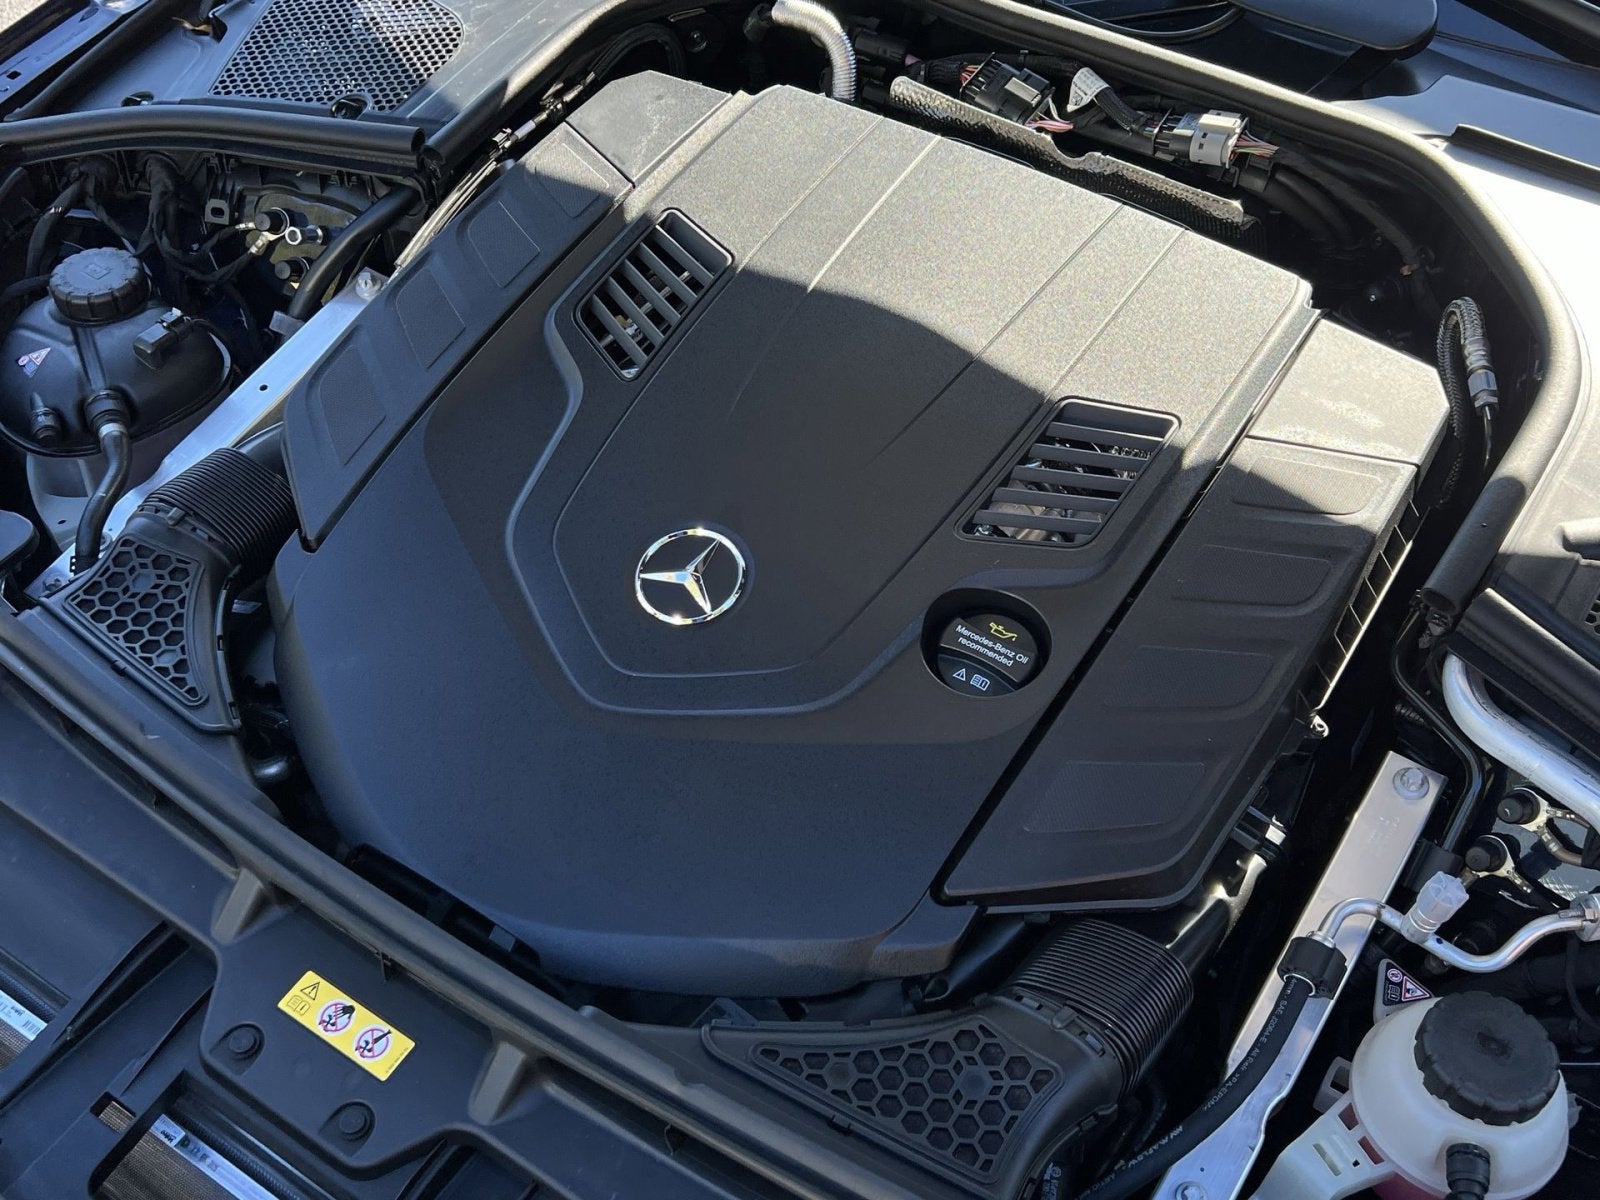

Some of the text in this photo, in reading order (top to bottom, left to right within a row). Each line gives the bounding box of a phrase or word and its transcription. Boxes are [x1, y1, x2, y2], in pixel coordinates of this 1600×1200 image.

[955, 625, 1029, 664] Mercedes-Benz Oil
[958, 637, 1014, 667] recommended
